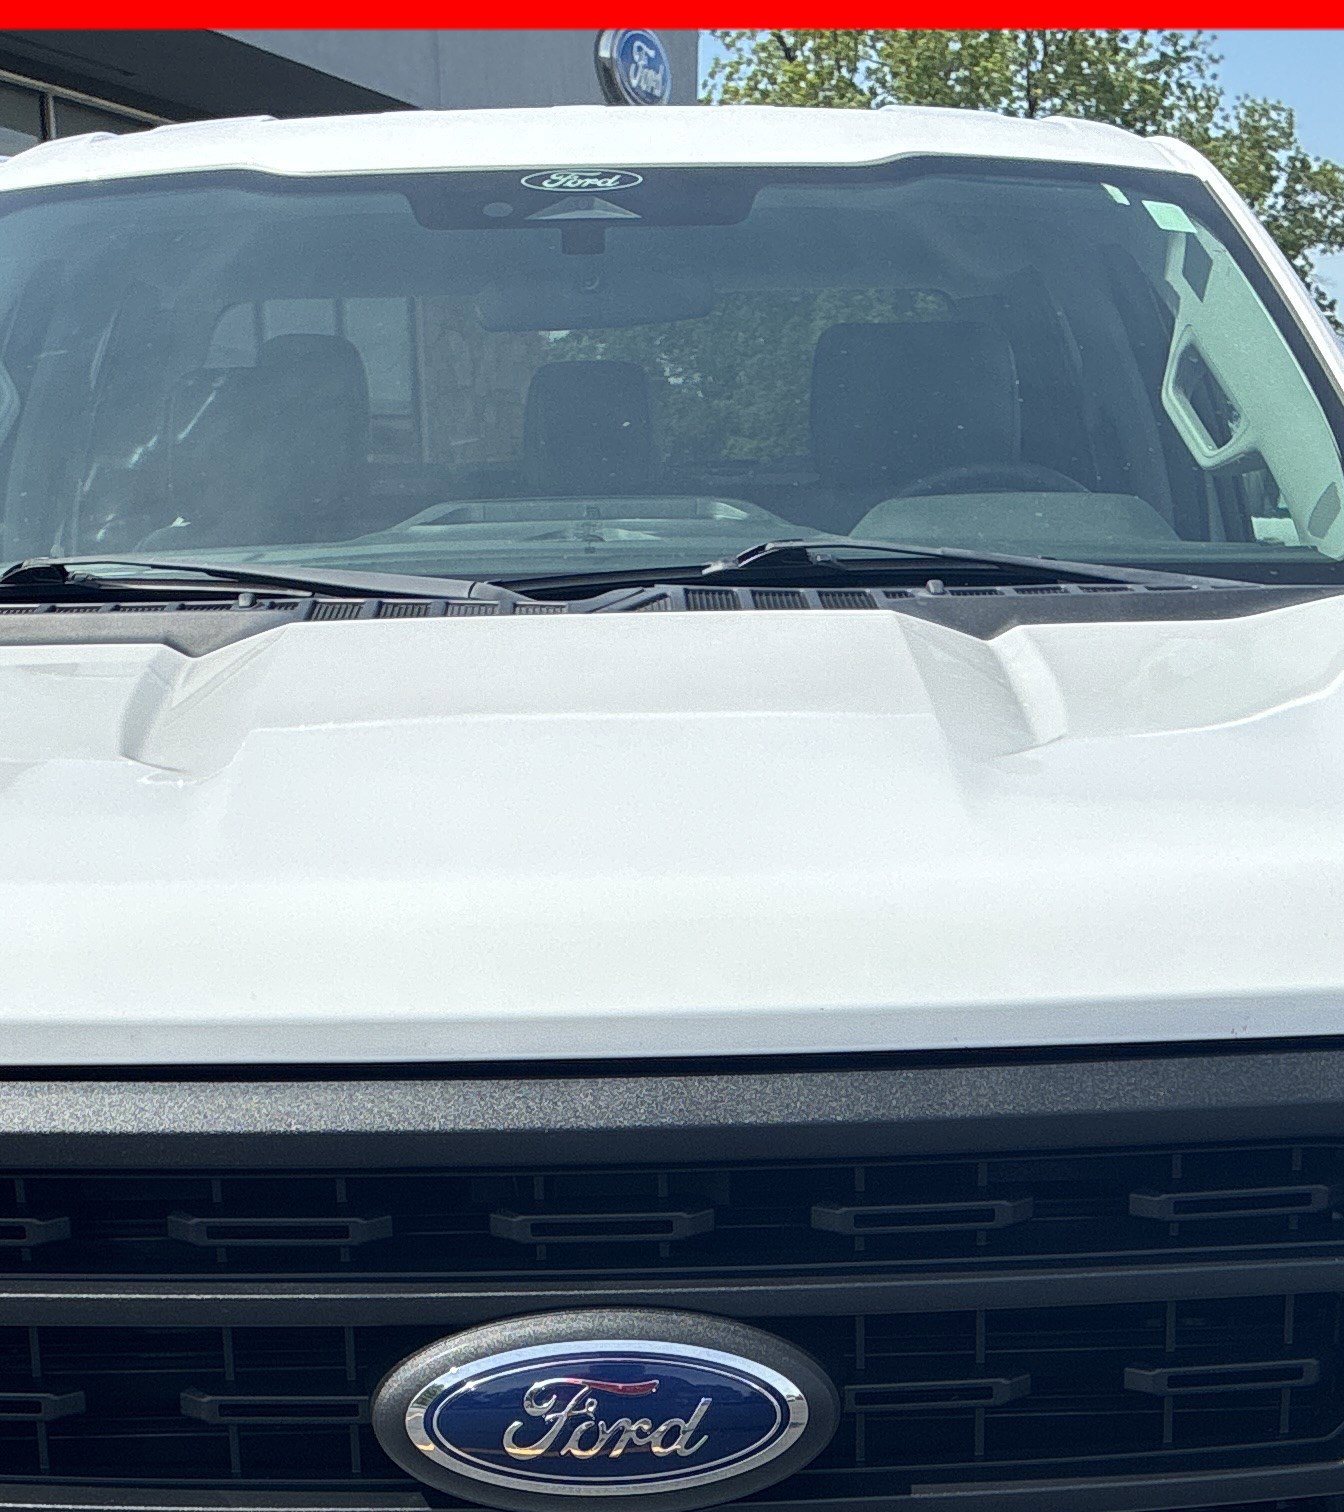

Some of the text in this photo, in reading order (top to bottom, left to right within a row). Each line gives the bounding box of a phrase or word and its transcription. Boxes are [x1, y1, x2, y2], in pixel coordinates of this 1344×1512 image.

[629, 40, 665, 97] Ford
[542, 171, 622, 188] Ford
[502, 1377, 713, 1461] Ford
